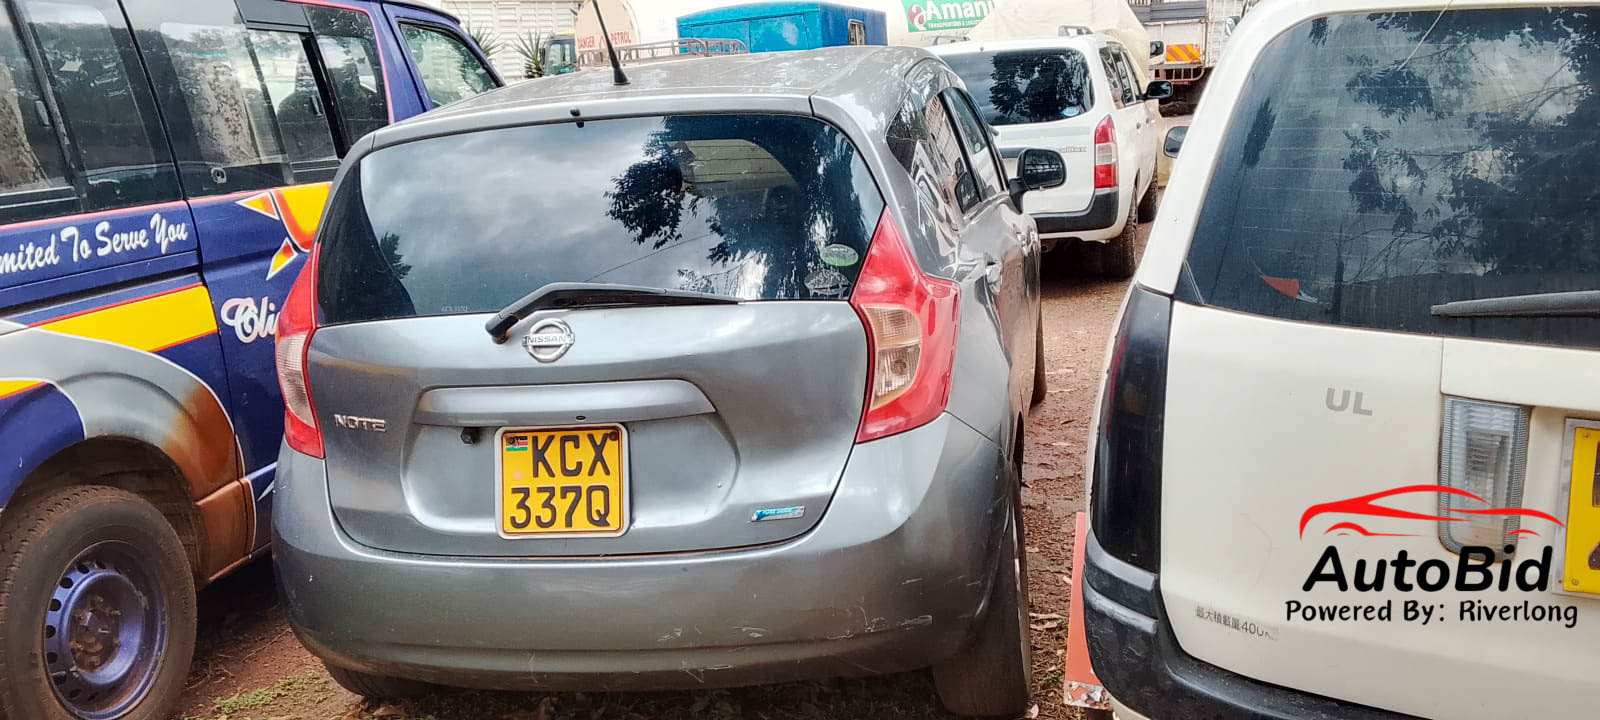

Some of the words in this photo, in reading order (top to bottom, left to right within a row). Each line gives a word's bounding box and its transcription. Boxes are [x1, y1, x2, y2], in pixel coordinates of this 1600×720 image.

[60, 226, 92, 262] To
[95, 221, 150, 257] Serve
[150, 212, 188, 254] You
[220, 295, 281, 344] Cli
[527, 335, 567, 344] NISSAN
[333, 413, 386, 432] NOTE
[1325, 387, 1373, 416] UL
[532, 433, 611, 478] KCX
[509, 484, 610, 529] 337Q
